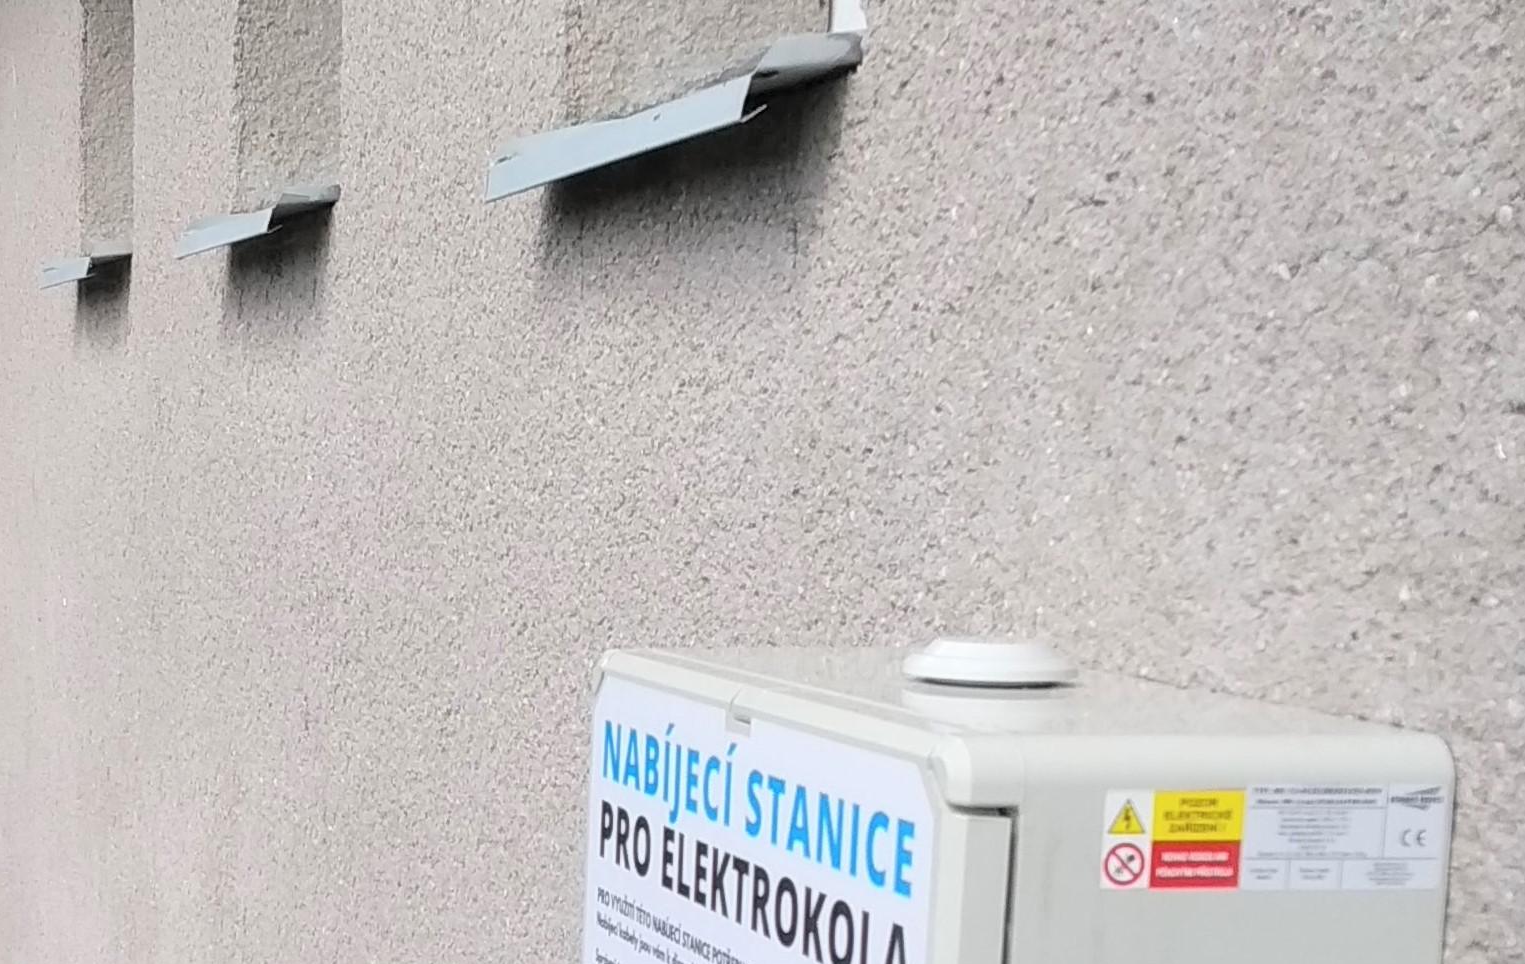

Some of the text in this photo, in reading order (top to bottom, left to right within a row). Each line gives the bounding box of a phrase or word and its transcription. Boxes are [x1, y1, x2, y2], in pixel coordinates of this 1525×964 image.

[599, 800, 651, 877] PRO
[603, 719, 916, 898] NABÍJECÍ STANICE
[596, 886, 610, 907] PRO
[651, 914, 681, 944] NABÍJECÍ
[681, 930, 711, 961] STANICE
